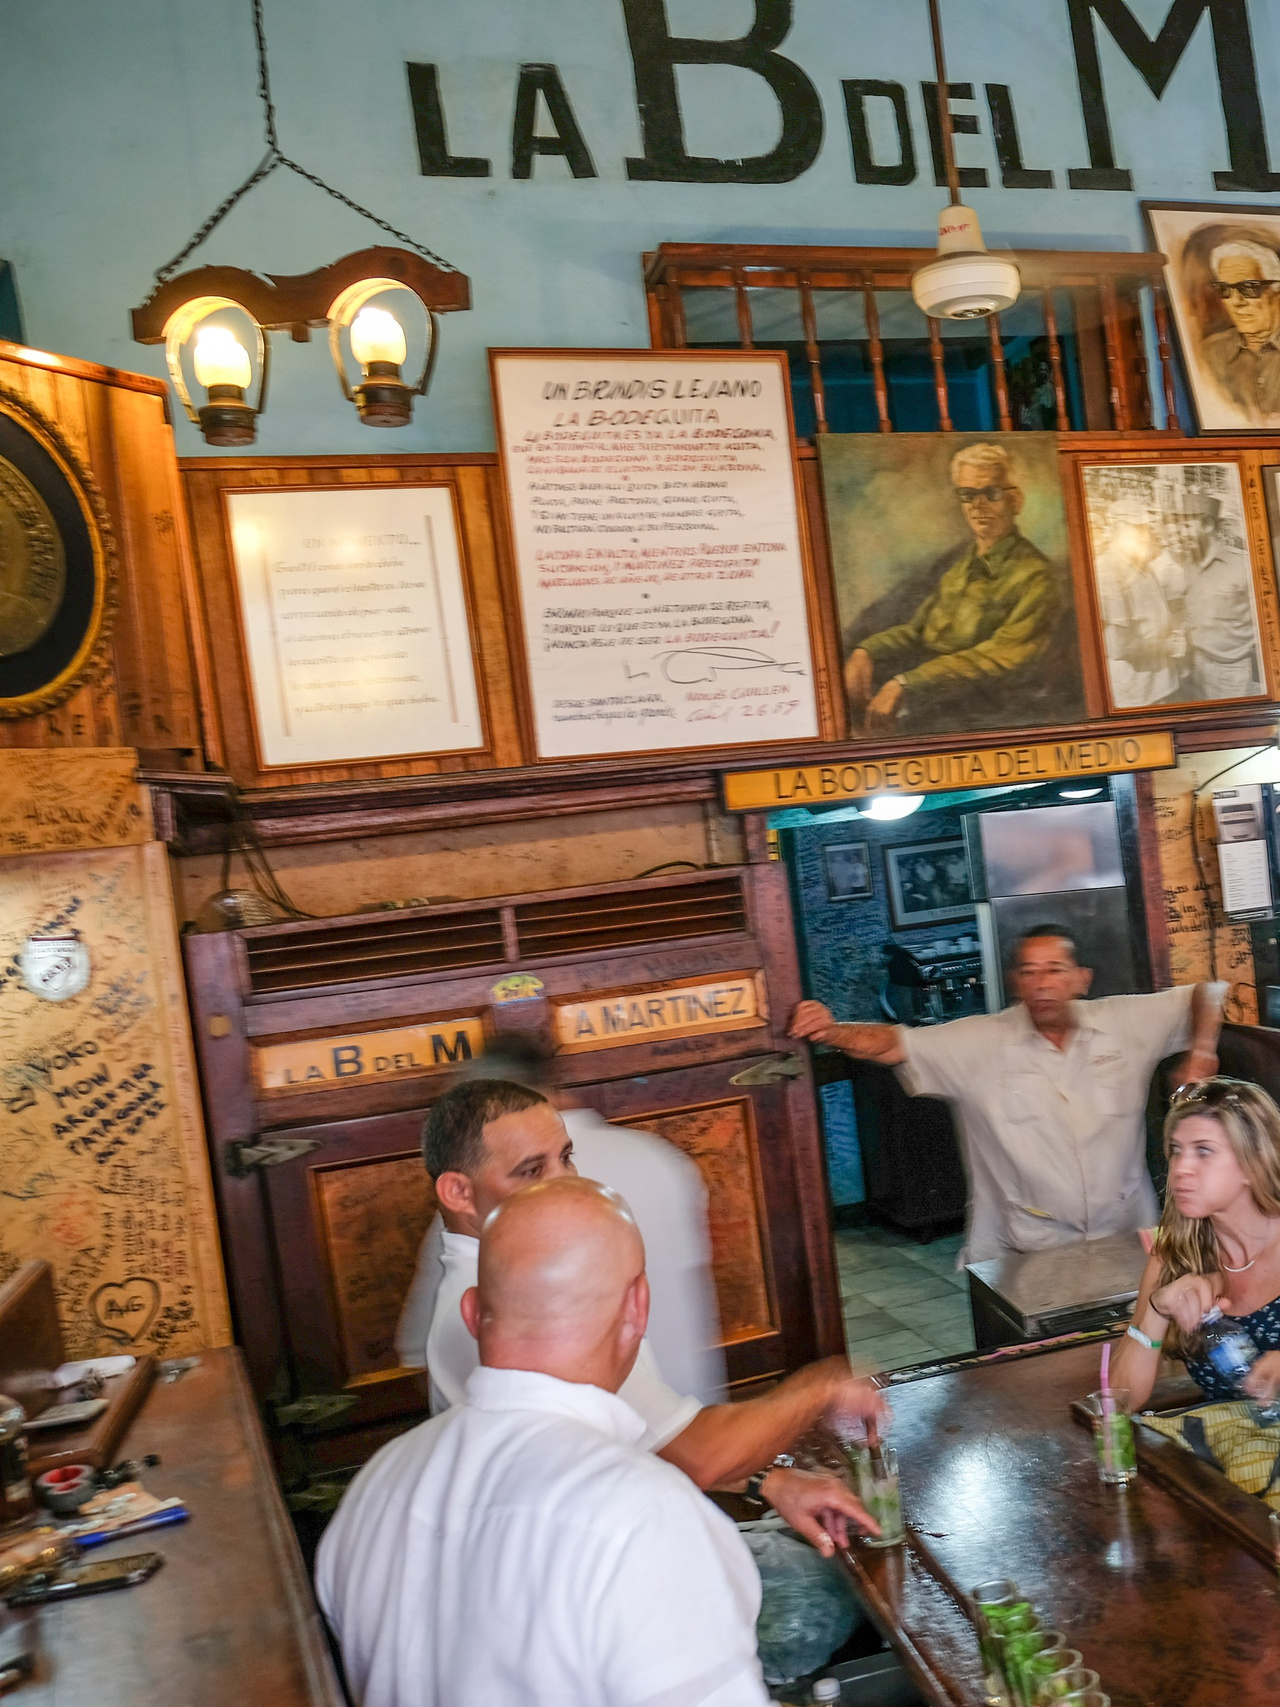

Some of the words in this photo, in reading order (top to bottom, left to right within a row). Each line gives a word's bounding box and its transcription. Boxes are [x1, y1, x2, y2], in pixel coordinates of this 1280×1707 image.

[405, 61, 598, 180] LA
[626, 0, 825, 185] B
[840, 78, 1056, 190] DEL
[574, 379, 668, 401] BRINDIS
[672, 379, 762, 400] LEJANO
[552, 412, 579, 428] LA
[586, 409, 720, 427] BODEGUITA
[773, 769, 814, 800] LA
[820, 753, 990, 797] BODEGUITA
[994, 747, 1048, 779] DEL
[1053, 738, 1142, 773] MEDIO
[575, 1009, 598, 1039] A
[602, 986, 750, 1036] MARTINEZ
[284, 1064, 326, 1086] LA
[331, 1044, 367, 1079] B
[374, 1050, 423, 1074] DEL
[429, 1029, 473, 1065] M
